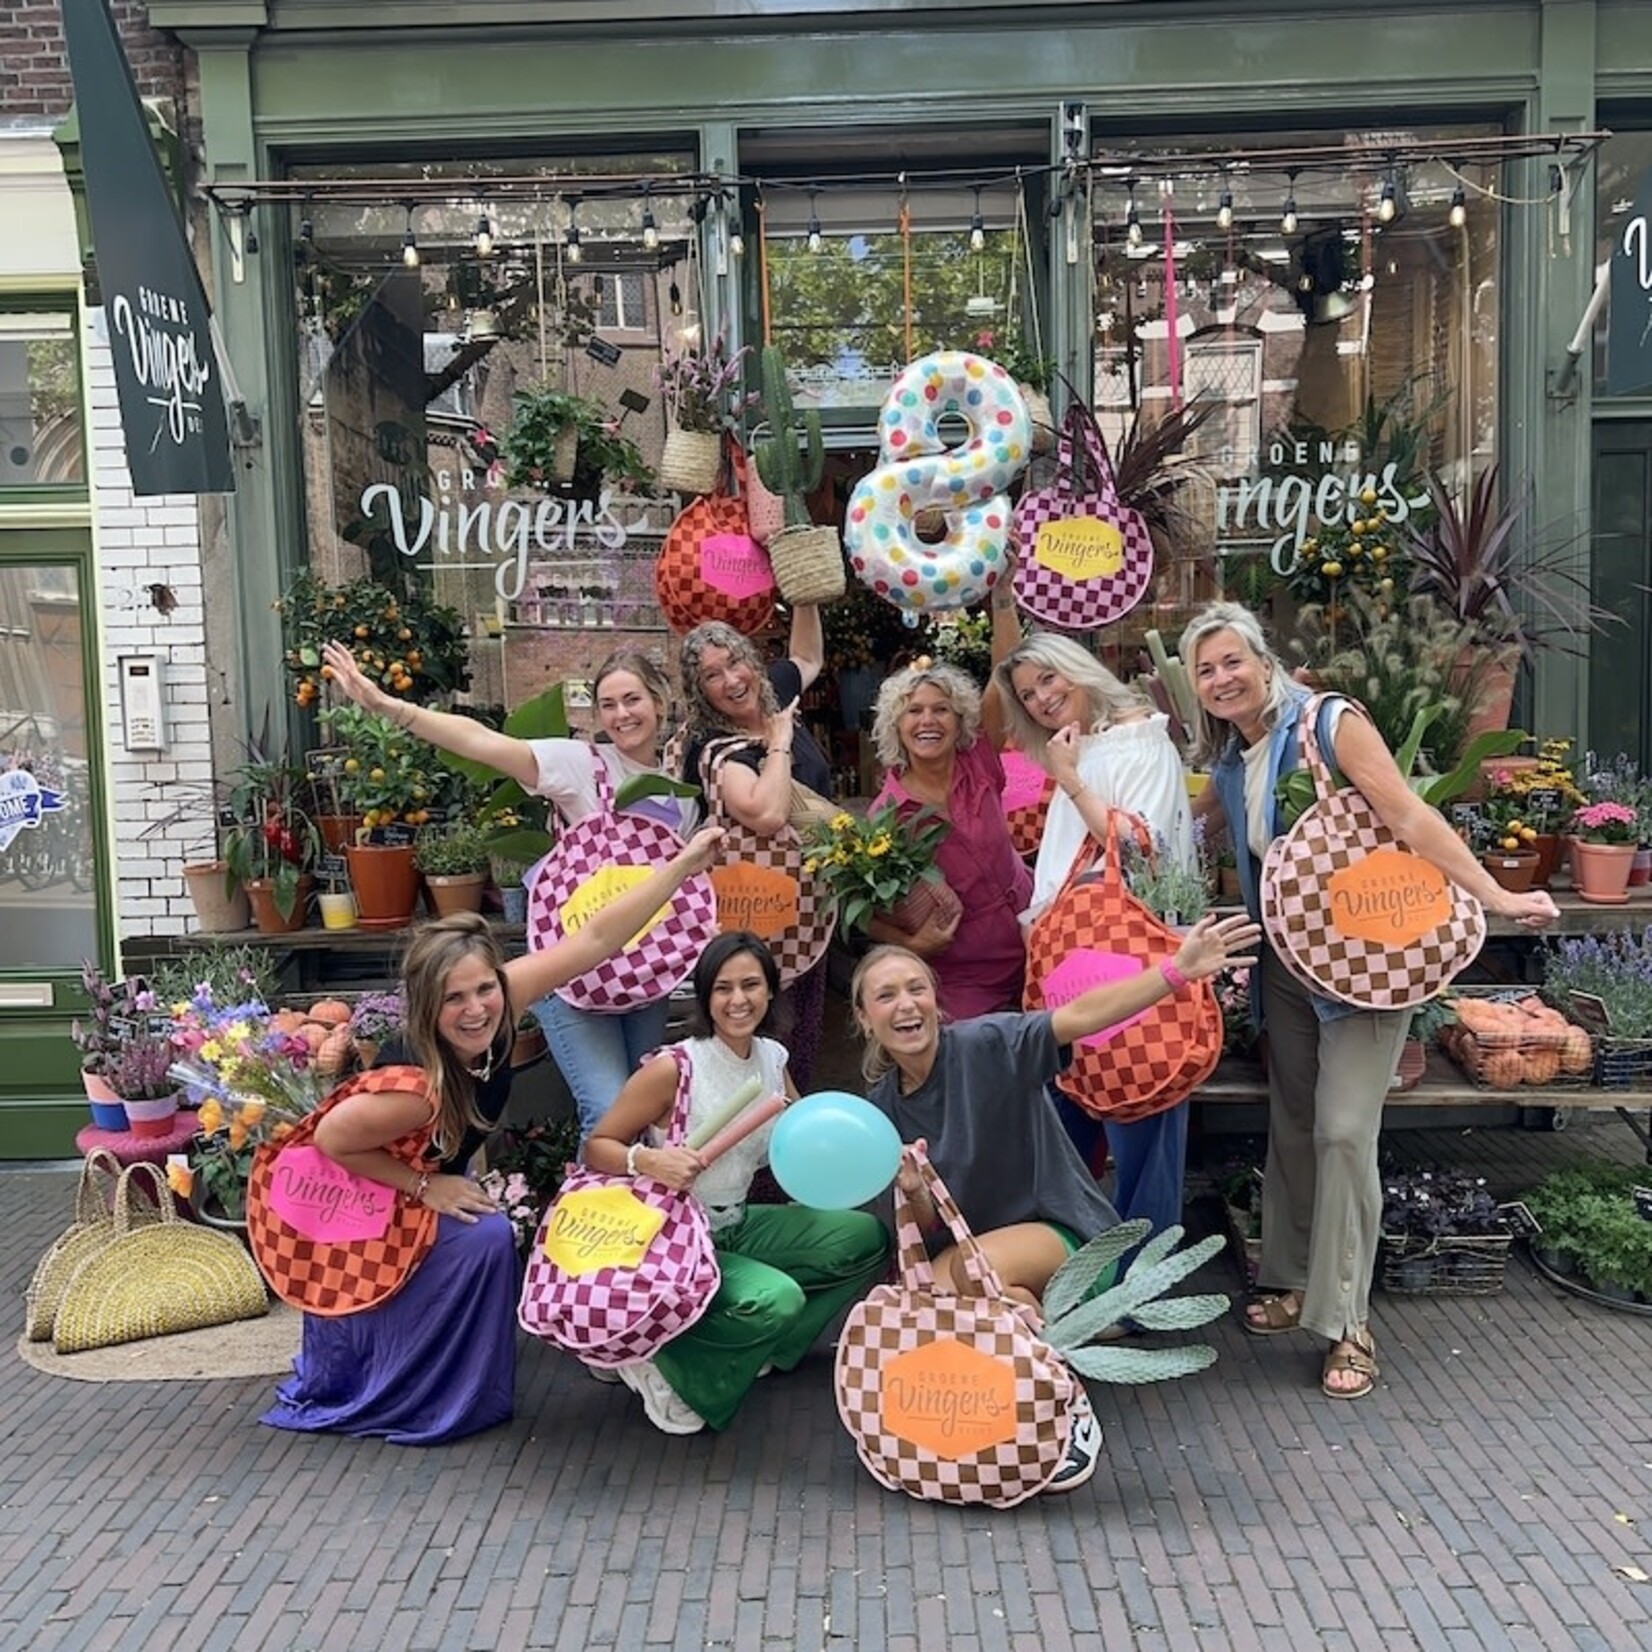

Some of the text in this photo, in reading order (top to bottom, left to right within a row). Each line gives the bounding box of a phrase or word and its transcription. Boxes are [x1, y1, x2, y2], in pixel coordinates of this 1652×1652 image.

[360, 484, 649, 600] Vingers
[1217, 462, 1432, 577] ingers
[1040, 532, 1119, 568] Vingers
[0, 795, 31, 819] OME
[721, 893, 792, 928] ingers
[1334, 879, 1442, 928] Vingers
[278, 1166, 386, 1223] Vingers
[554, 1207, 645, 1258] Vingers
[887, 1376, 1011, 1438] Vingers
